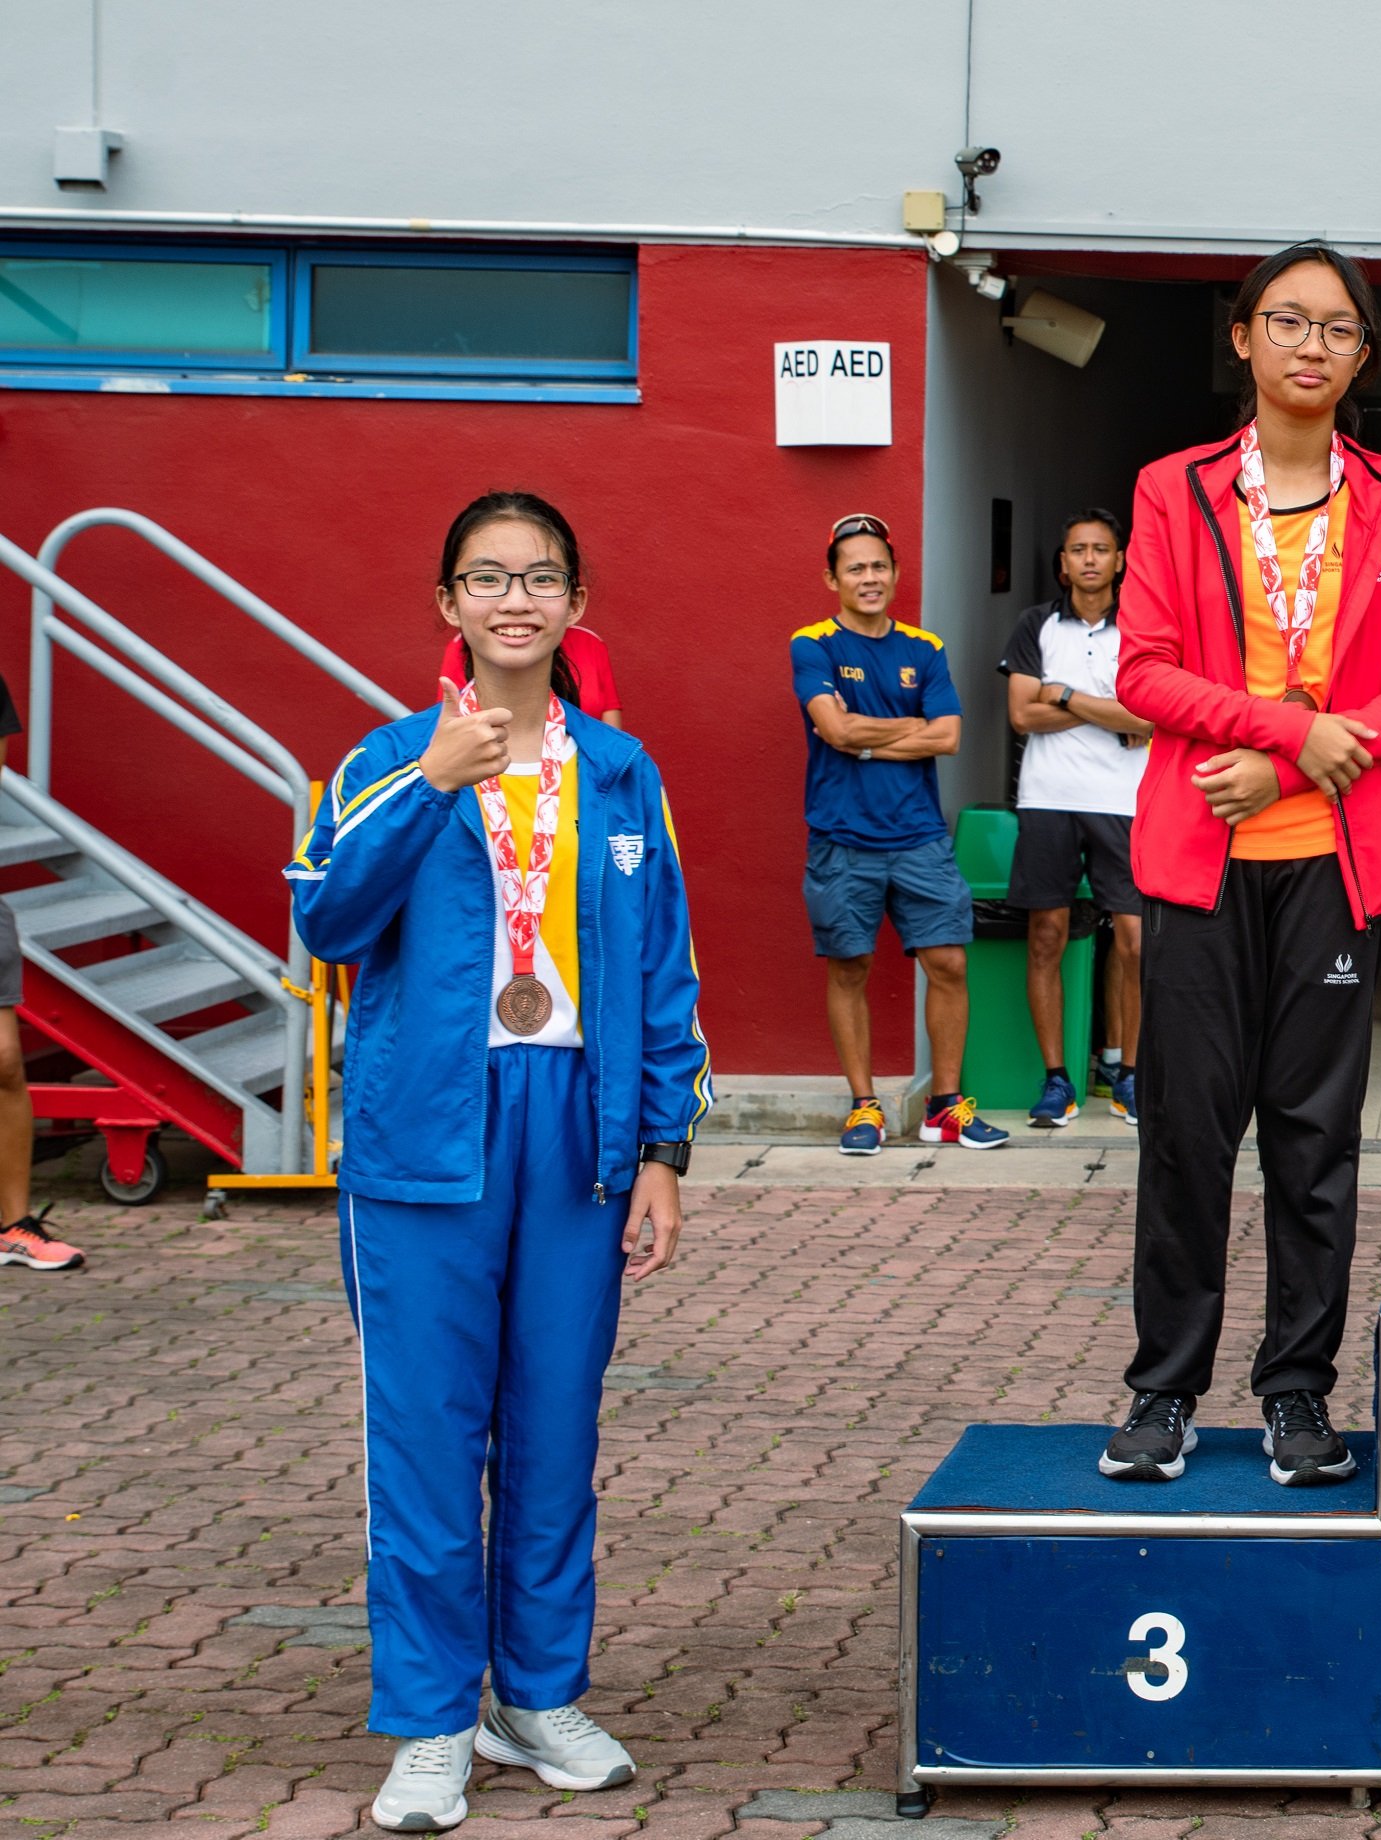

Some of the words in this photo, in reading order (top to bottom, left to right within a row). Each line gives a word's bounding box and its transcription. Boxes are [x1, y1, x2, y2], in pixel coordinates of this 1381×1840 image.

[781, 350, 819, 378] AED
[830, 349, 884, 378] AED
[1127, 1611, 1188, 1702] 3
